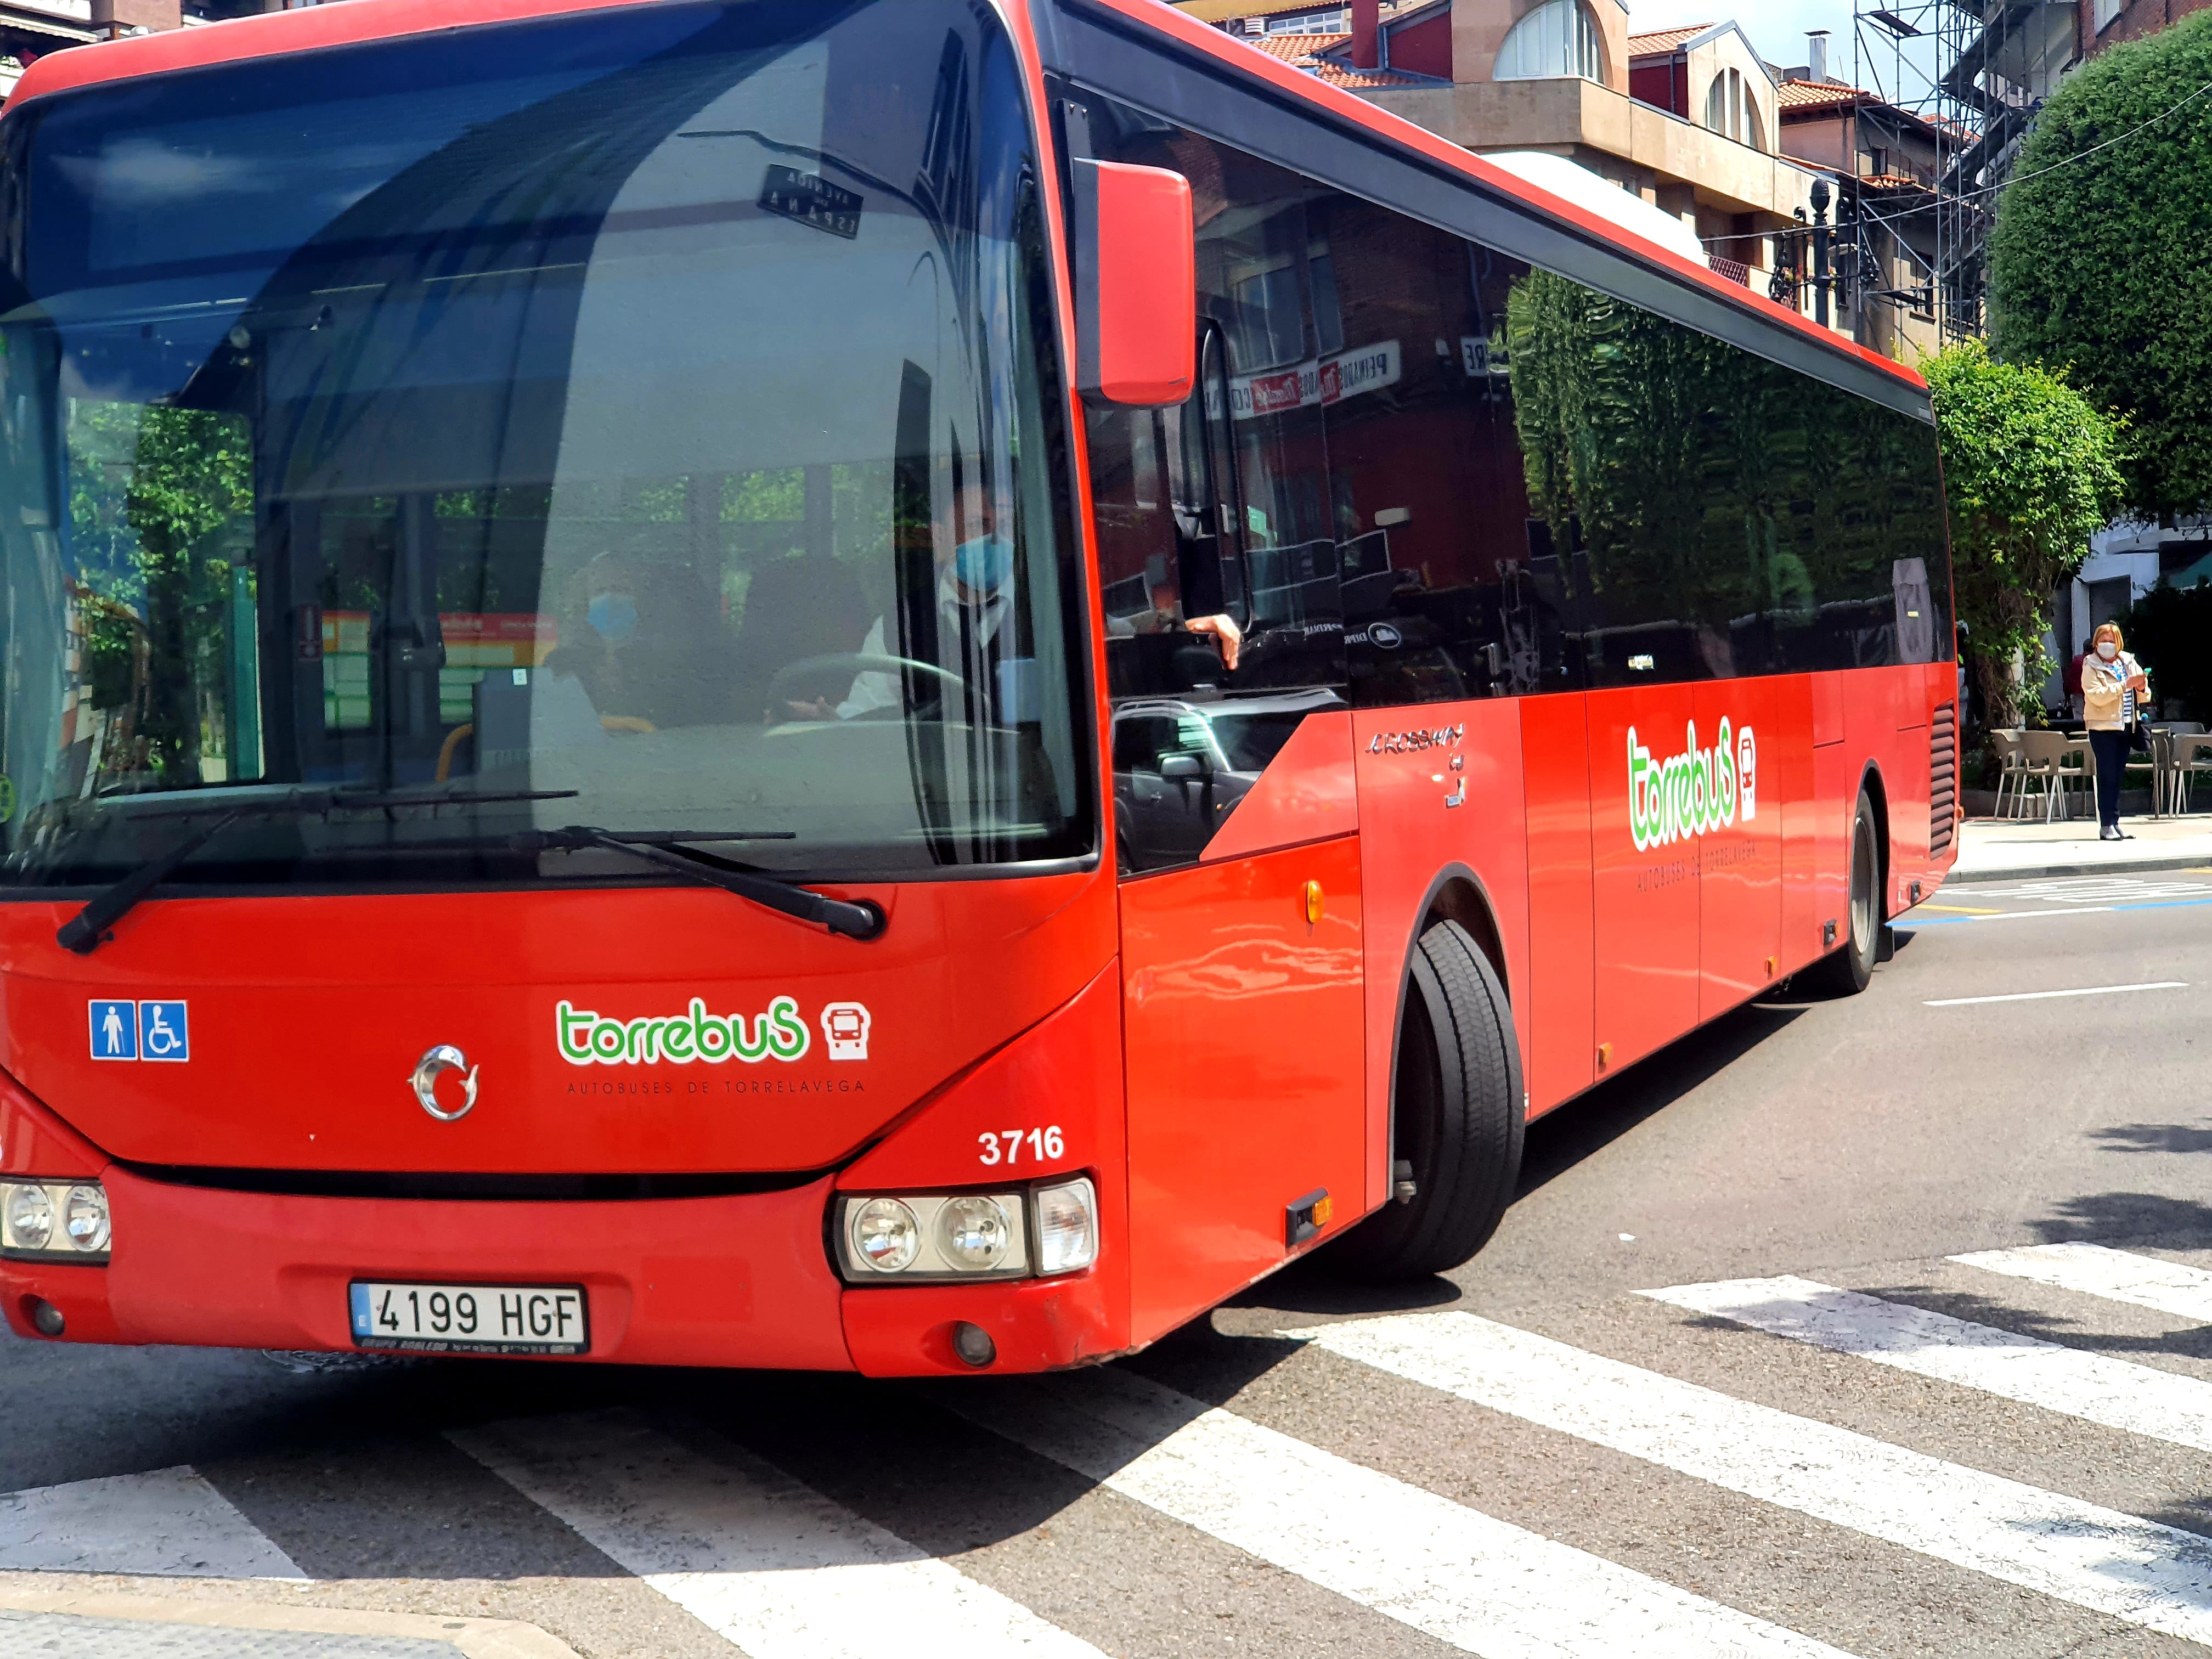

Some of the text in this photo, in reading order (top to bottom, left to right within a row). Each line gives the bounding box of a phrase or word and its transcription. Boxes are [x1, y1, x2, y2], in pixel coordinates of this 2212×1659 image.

[1365, 723, 1464, 755] CROSSWAY
[567, 1079, 865, 1095] AUTOBUSES DE TORRELAVEGA
[978, 1125, 1064, 1166] 3716
[379, 1289, 576, 1338] 4199 HGF
